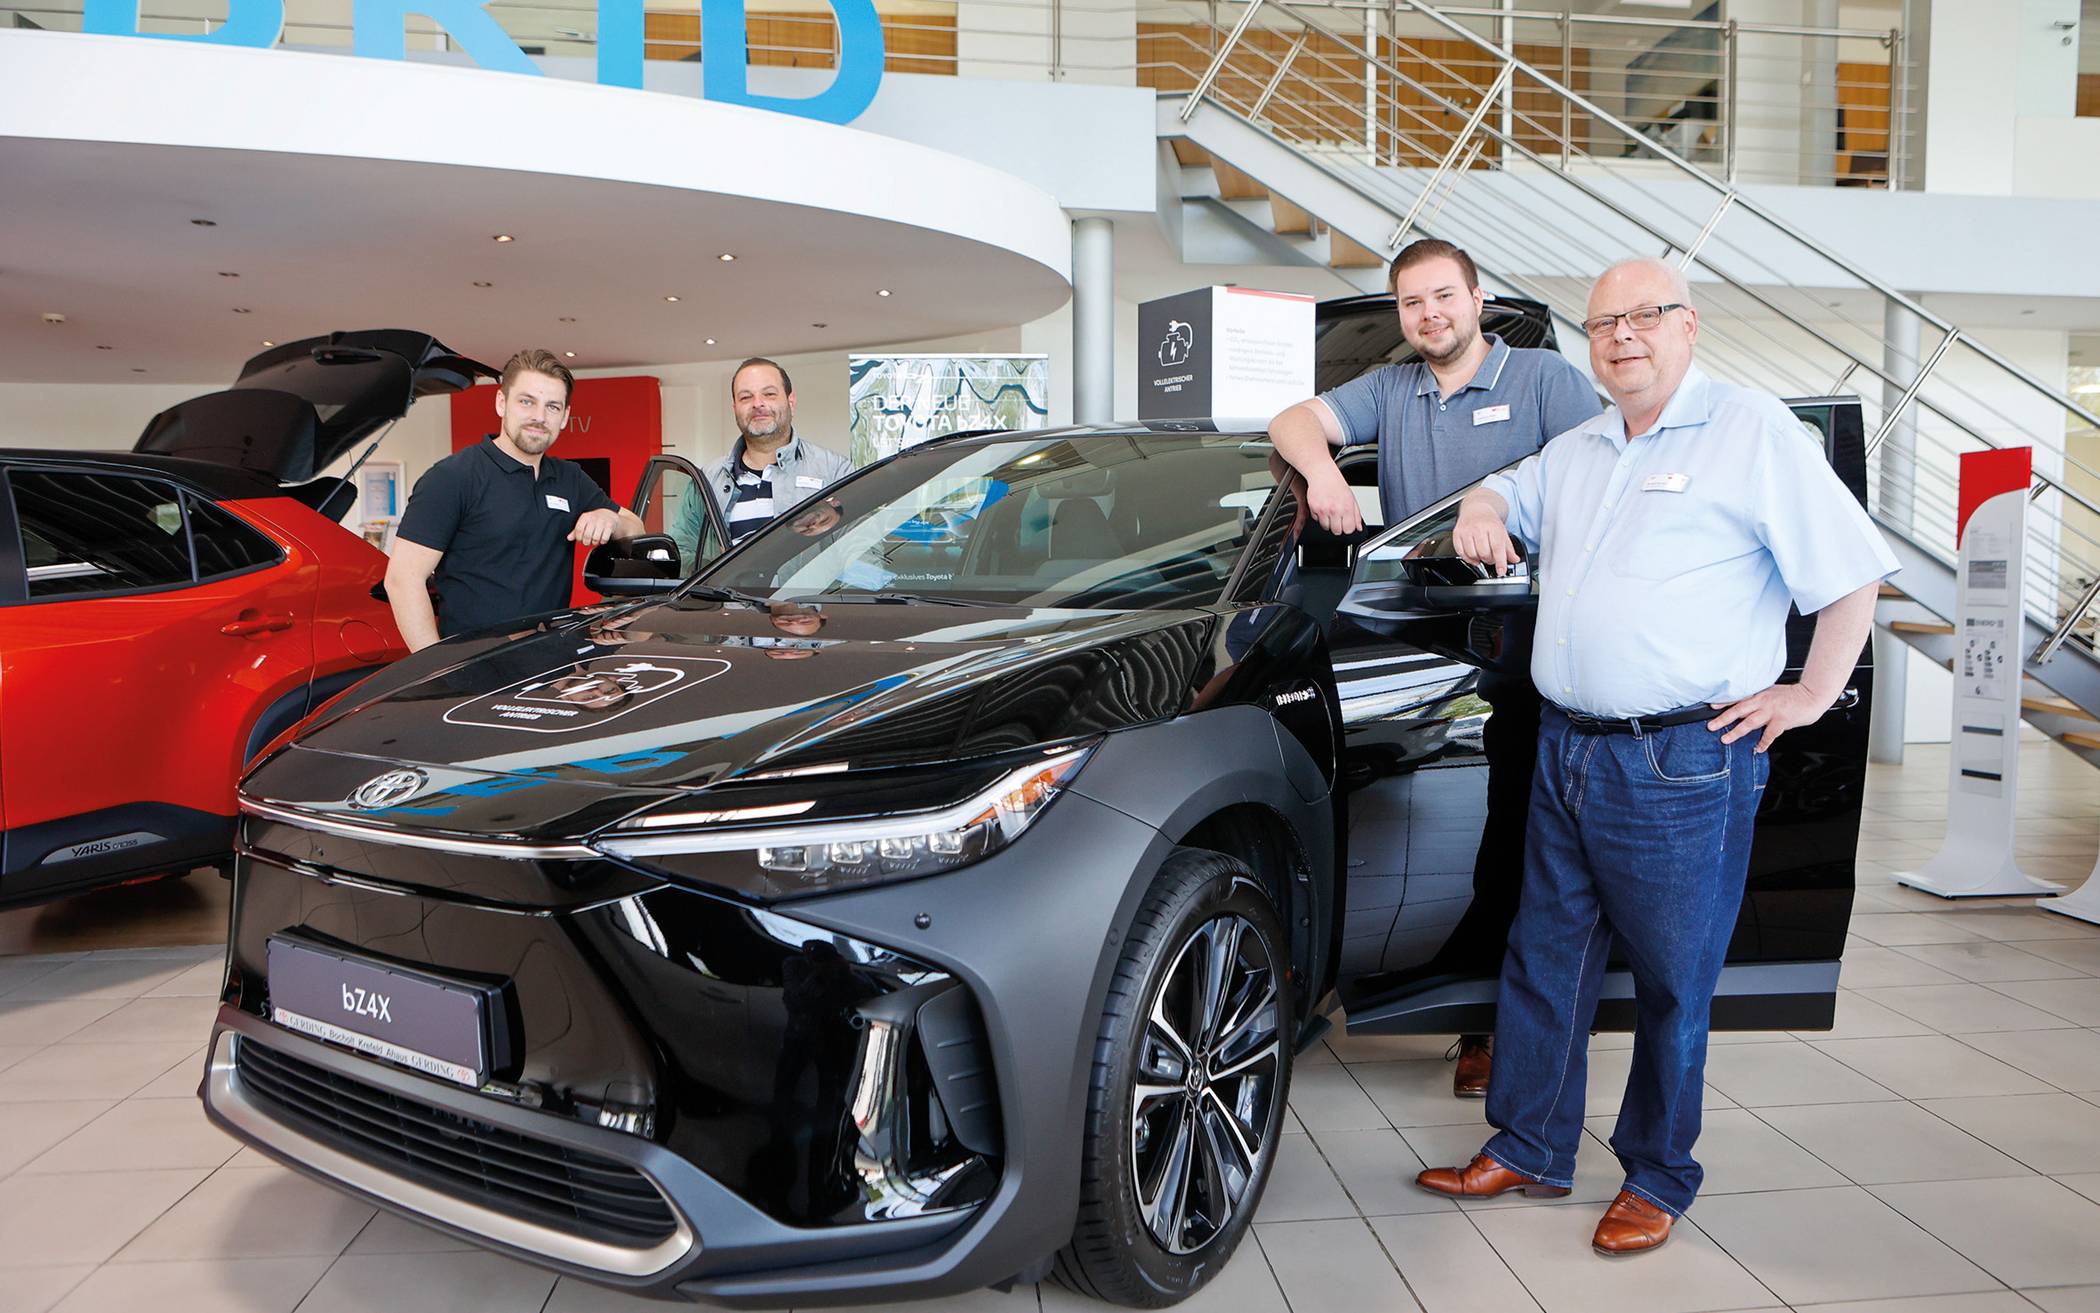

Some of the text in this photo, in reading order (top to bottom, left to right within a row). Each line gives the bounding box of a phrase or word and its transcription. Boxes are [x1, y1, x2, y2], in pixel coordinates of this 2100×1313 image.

[71, 842, 111, 857] YARIS
[342, 983, 393, 1024] bZ4X
[289, 1016, 327, 1036] GERDING
[386, 1048, 408, 1062] Ahaus
[411, 1056, 454, 1078] GERDING
